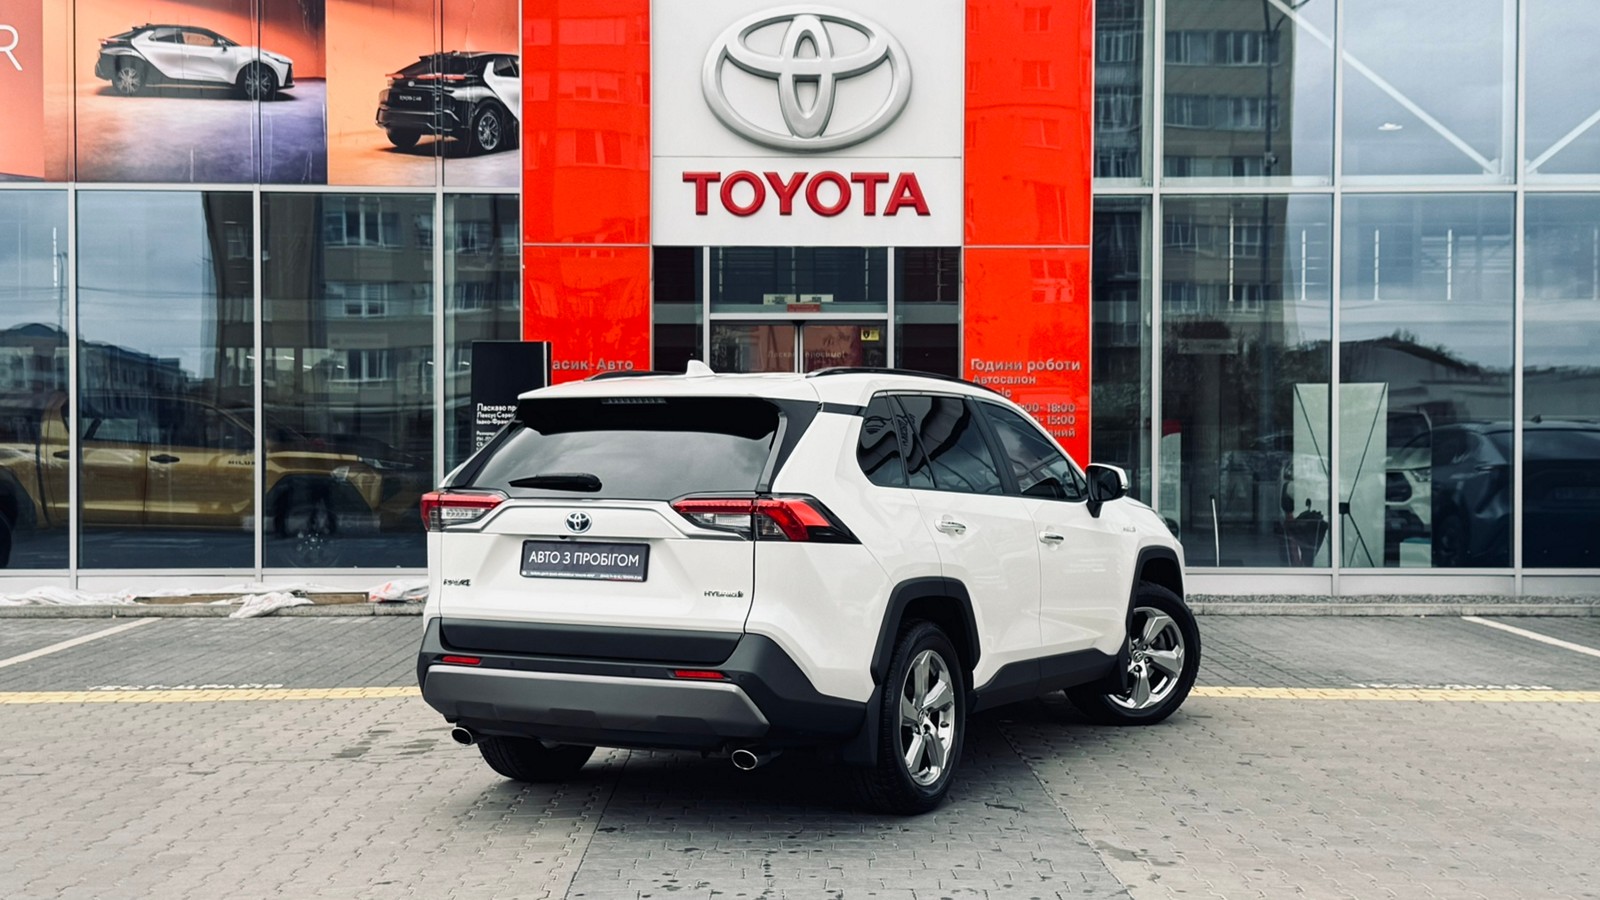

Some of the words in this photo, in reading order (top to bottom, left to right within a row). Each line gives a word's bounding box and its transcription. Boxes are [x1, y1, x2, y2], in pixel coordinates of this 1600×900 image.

[682, 170, 931, 217] TOYOTA
[970, 359, 1022, 372] Години
[1027, 358, 1081, 373] роботи
[972, 375, 1036, 385] Автосалон
[1047, 415, 1075, 425] 15:00
[528, 550, 561, 564] АВТО
[573, 551, 640, 567] ПРОБІГОМ
